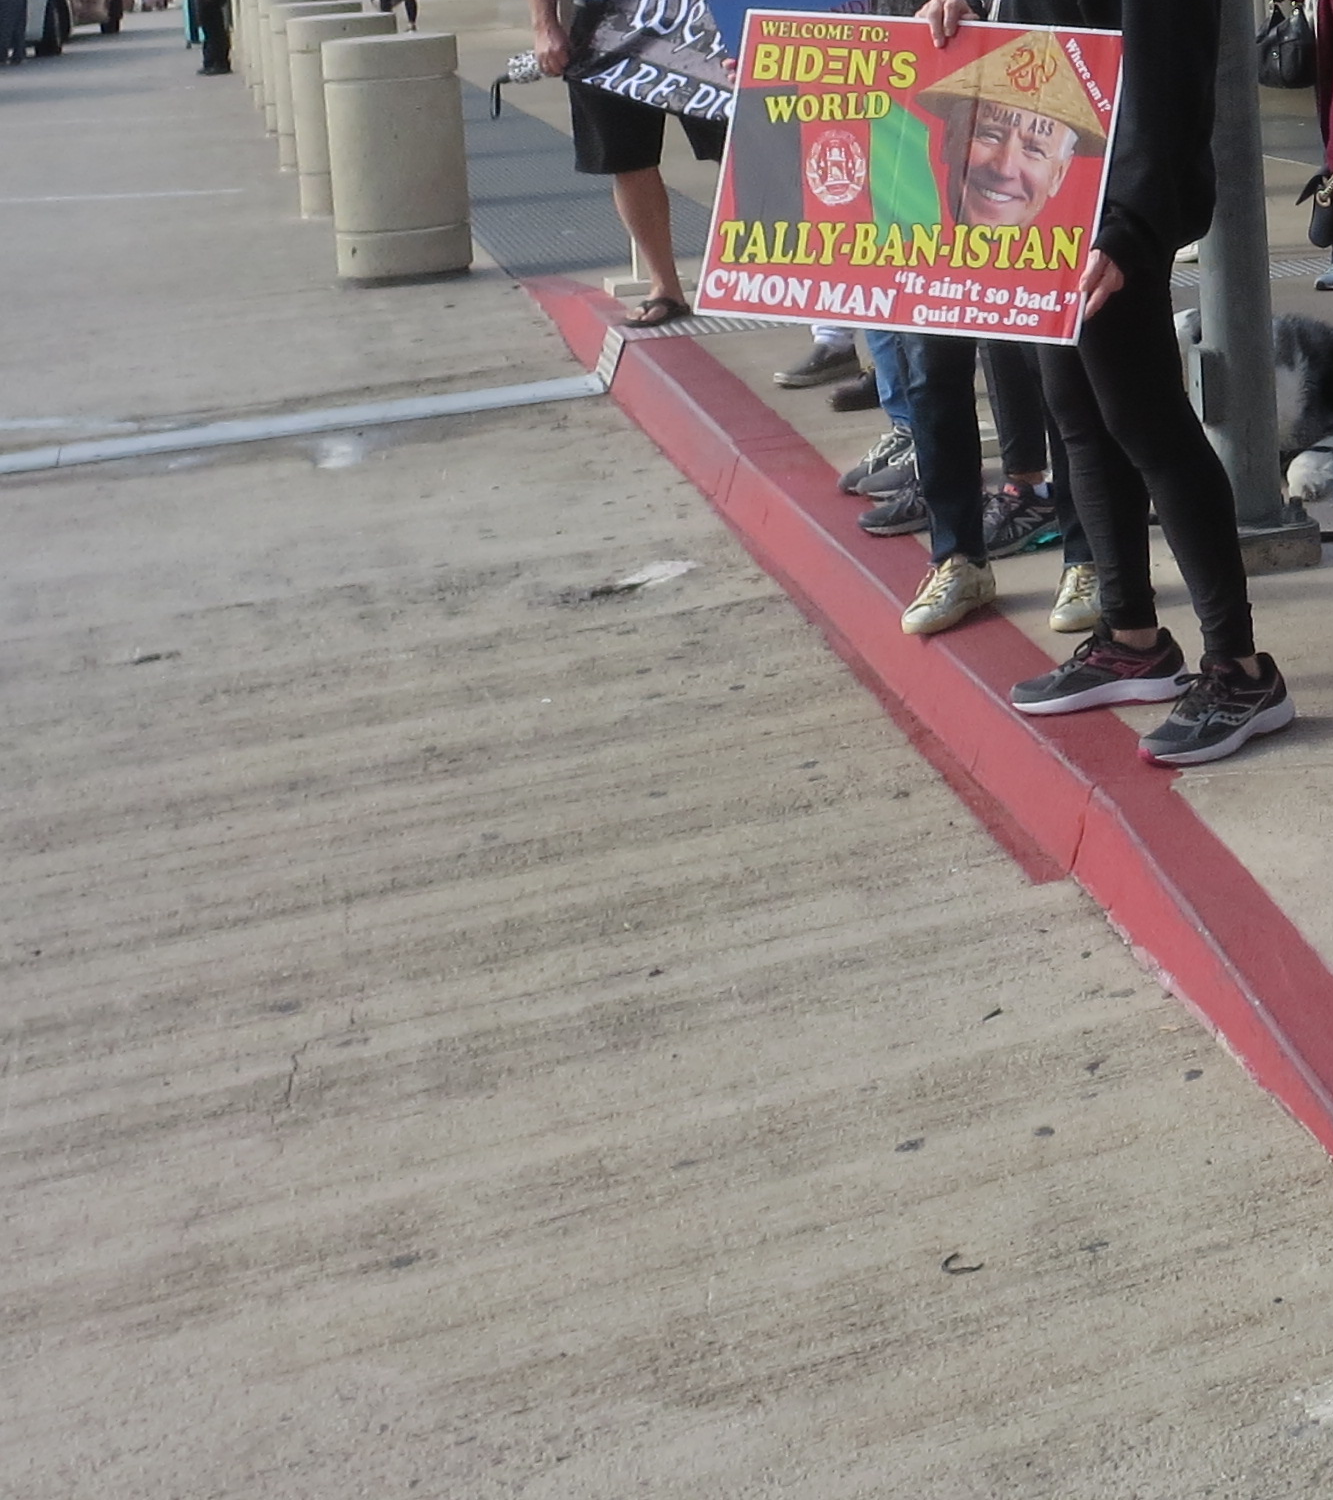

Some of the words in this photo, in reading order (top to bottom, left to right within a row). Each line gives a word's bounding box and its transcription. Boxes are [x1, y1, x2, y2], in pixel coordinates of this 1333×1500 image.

[760, 21, 855, 43] WELCOME
[859, 26, 890, 43] TO:
[582, 57, 689, 109] ARE
[752, 43, 918, 90] BIDEN'S
[1065, 37, 1091, 80] Where
[1086, 78, 1102, 100] am
[765, 90, 892, 125] WORLD
[981, 103, 1022, 128] DUMB
[1027, 116, 1055, 137] ASS
[718, 218, 1085, 271] TALLY-BAN-ISTAN
[705, 268, 814, 312] C'MON
[815, 279, 898, 319] MAN
[928, 274, 980, 303] ain't
[983, 288, 1010, 305] so
[911, 305, 960, 325] Quid
[963, 307, 999, 327] Pro
[1001, 308, 1040, 328] Joe
